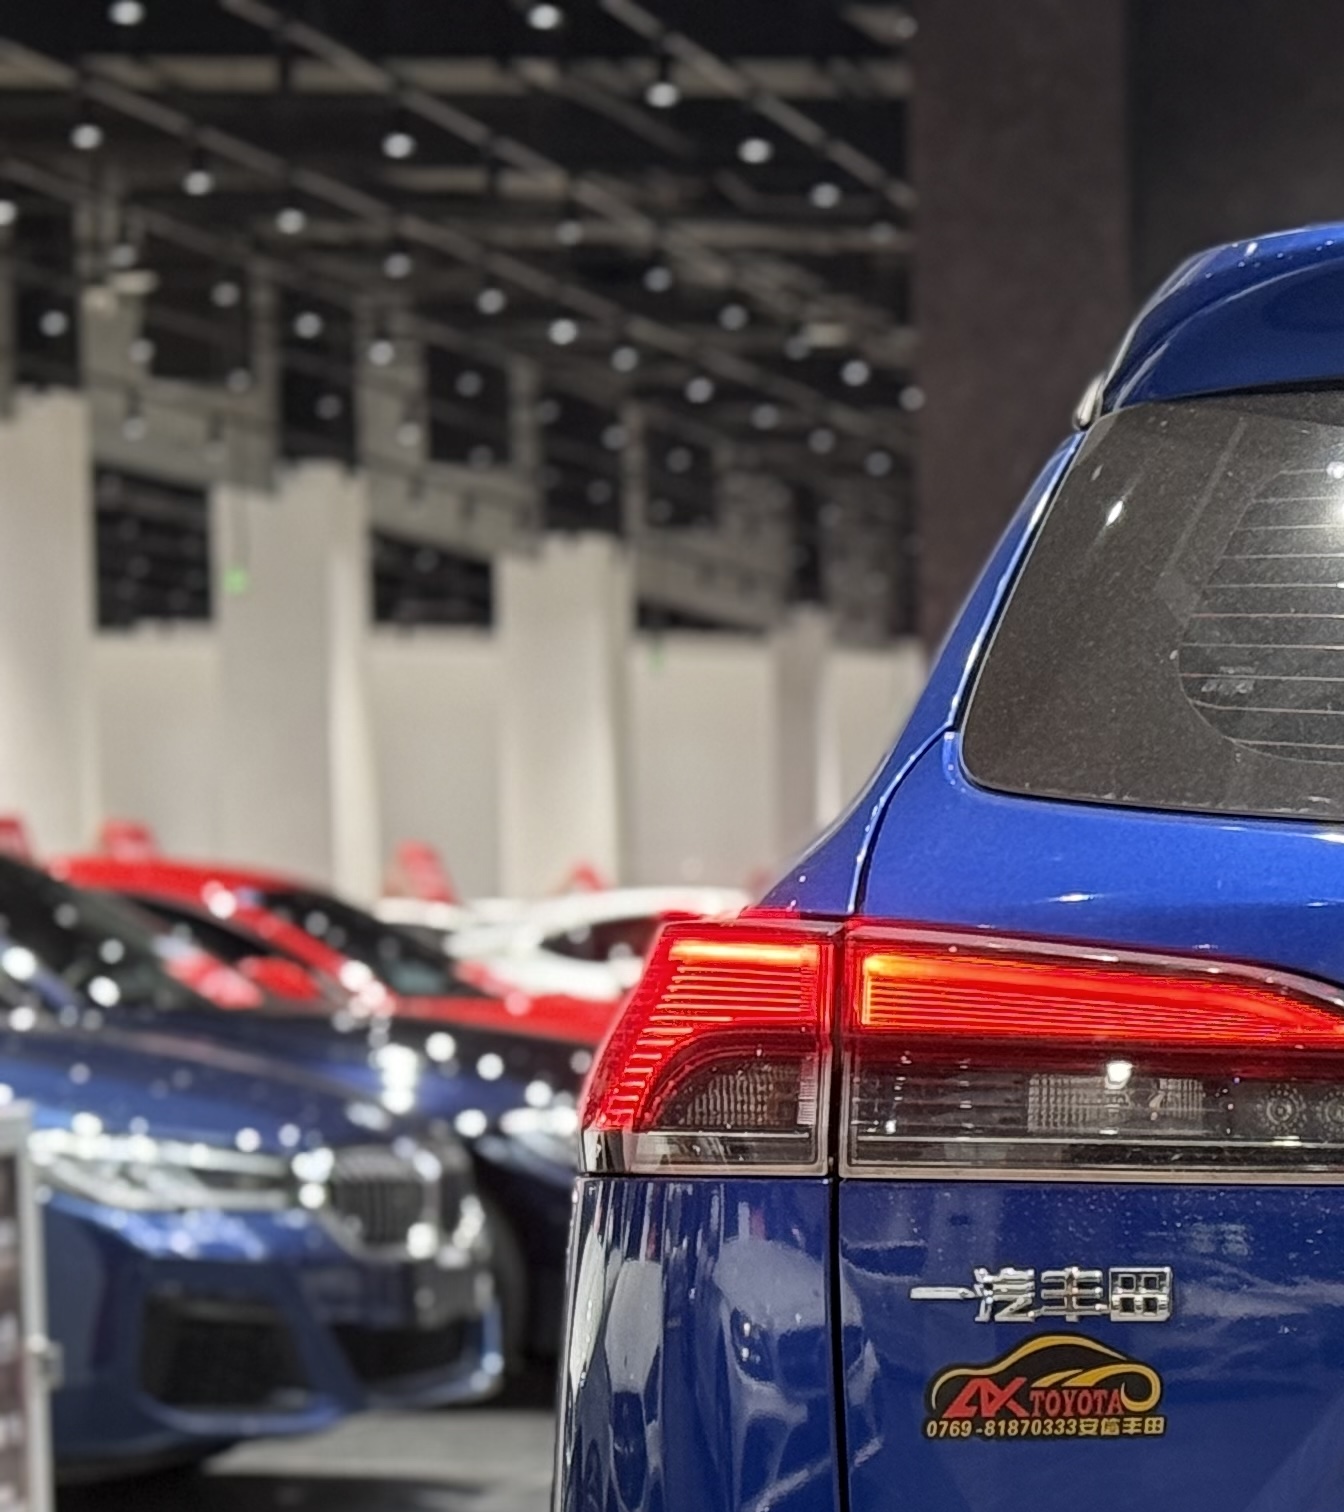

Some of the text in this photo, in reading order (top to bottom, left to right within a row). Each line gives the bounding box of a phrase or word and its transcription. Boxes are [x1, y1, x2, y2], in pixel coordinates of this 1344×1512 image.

[909, 1266, 1173, 1322] 一汽丰田
[1029, 1389, 1124, 1417] TOYOTA
